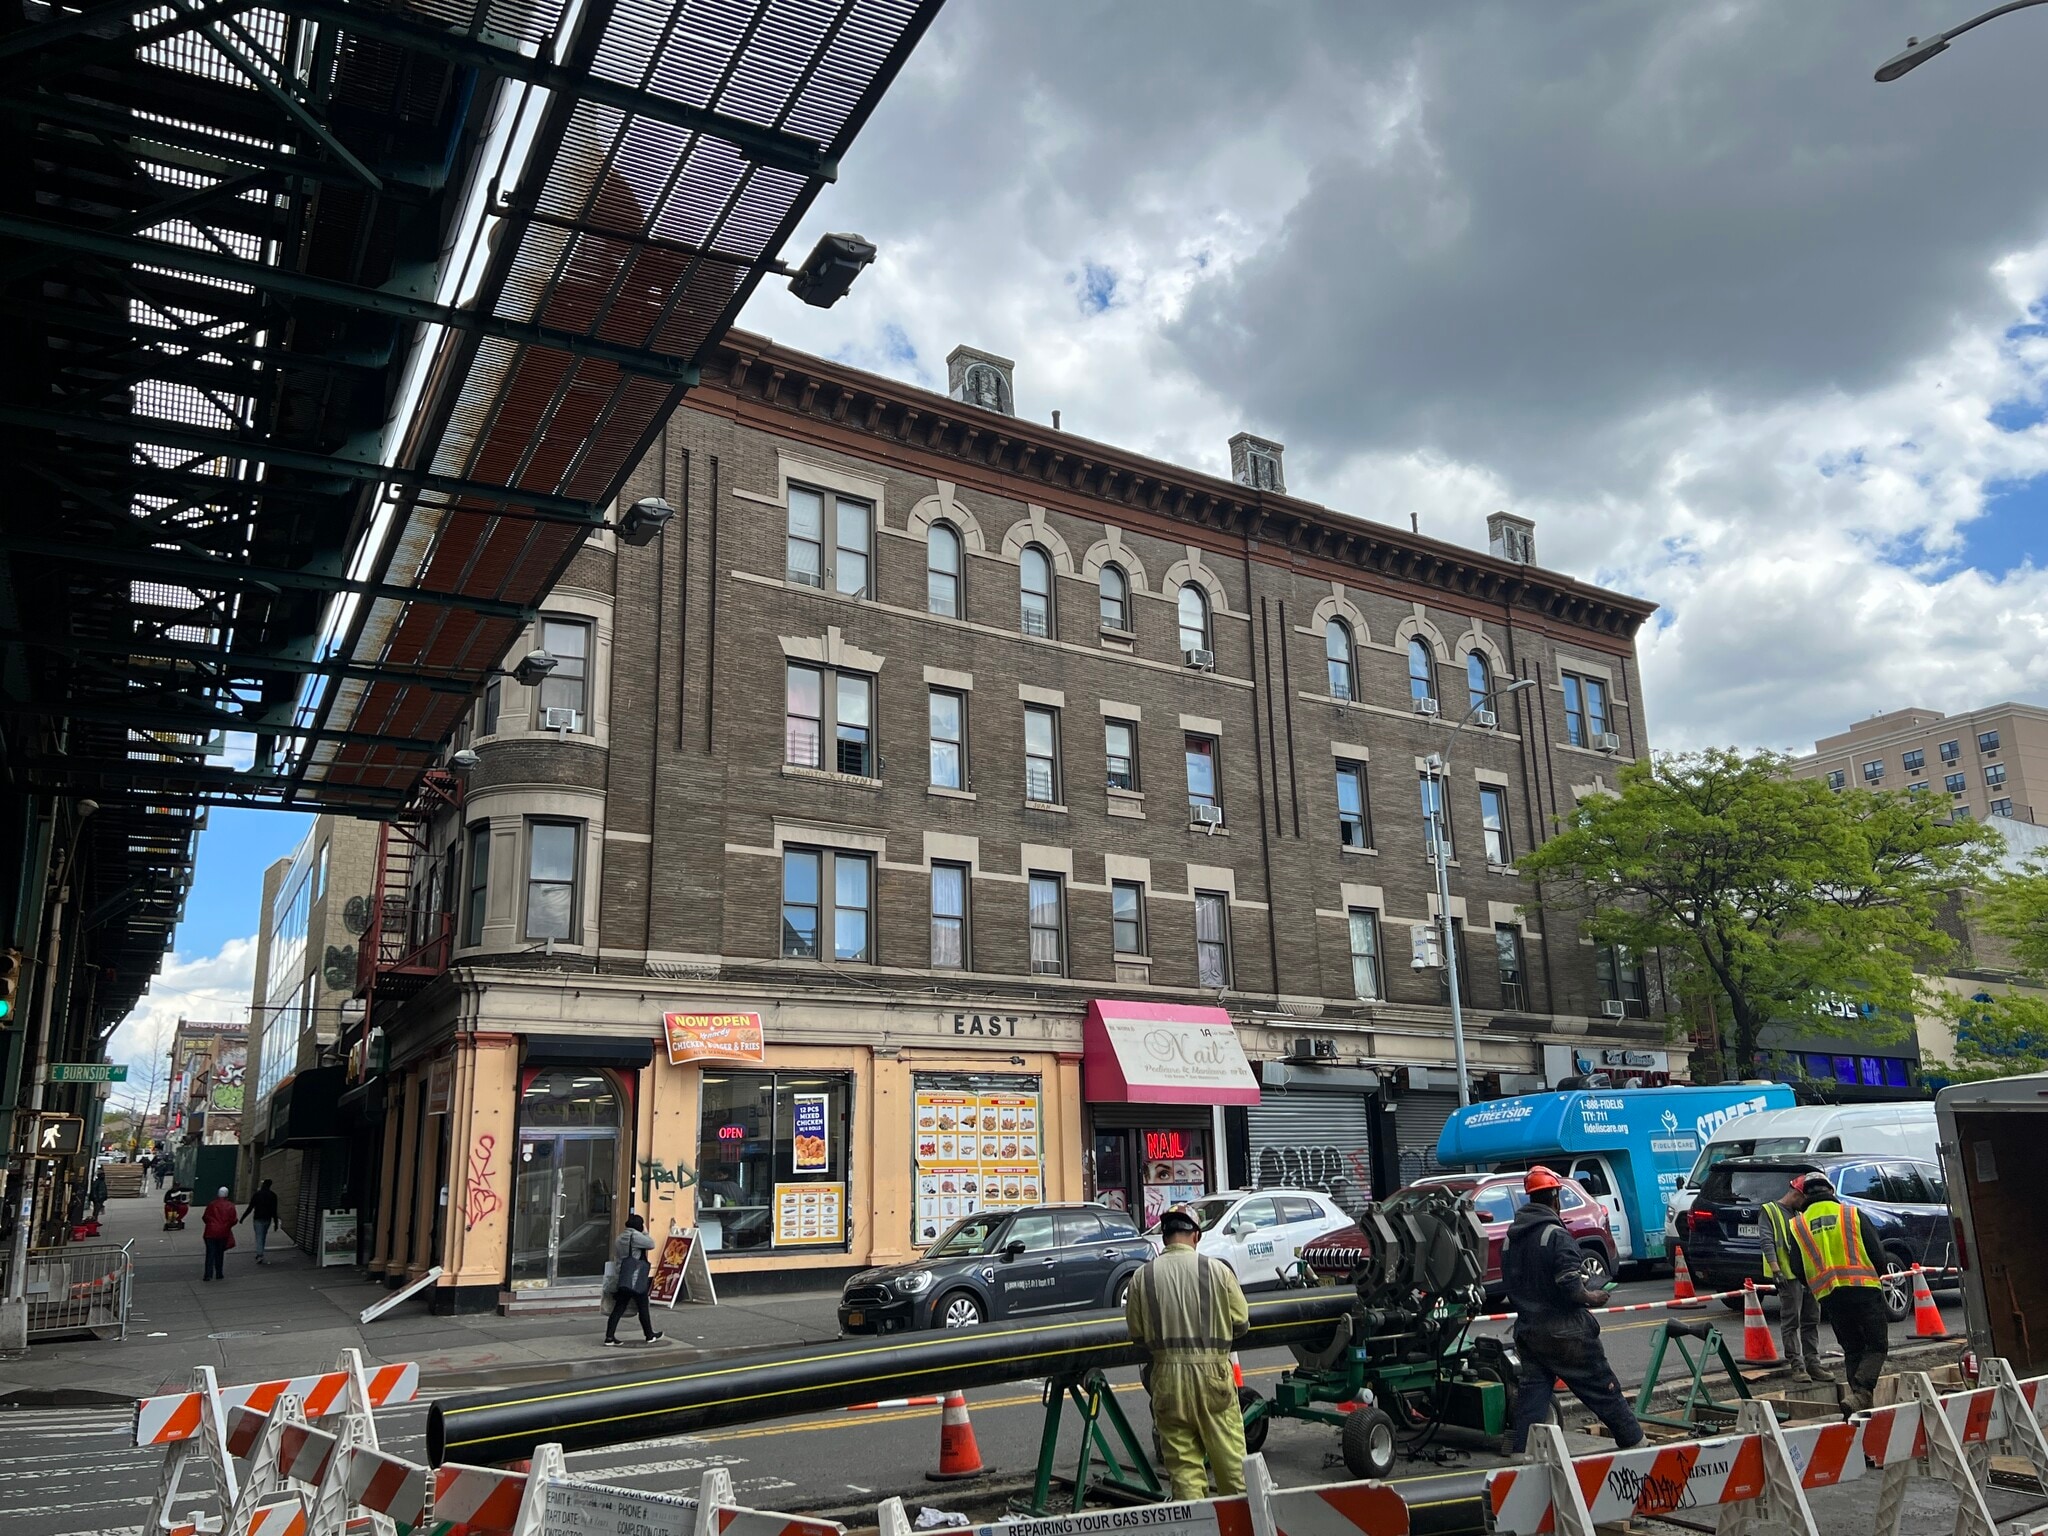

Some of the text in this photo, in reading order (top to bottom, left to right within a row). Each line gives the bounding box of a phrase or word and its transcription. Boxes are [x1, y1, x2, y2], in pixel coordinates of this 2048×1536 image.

[675, 1016, 750, 1027] NOW OPEN
[954, 1014, 1018, 1037] EAST
[672, 1041, 760, 1052] CHICKEN, BURGER & FRIES
[1144, 1029, 1226, 1065] Nail
[51, 1066, 125, 1080] E BURNSIDE AV
[1580, 1099, 1625, 1110] 1-888-FIDELIS
[1464, 1106, 1533, 1127] #STREETSIDE
[1581, 1111, 1609, 1121] TTY: 711
[719, 1127, 743, 1139] OPEN
[1584, 1123, 1629, 1134] fideliscare.org
[1147, 1132, 1184, 1159] NAIL
[1653, 1141, 1694, 1150] FIDELIS CARE
[1688, 1460, 1729, 1480] RESTANI
[547, 1490, 566, 1506] ERMIT
[545, 1508, 562, 1523] TART
[617, 1502, 642, 1519] PHONE
[1008, 1505, 1193, 1536] REPAIRING YOUR GAS SYSTEM
